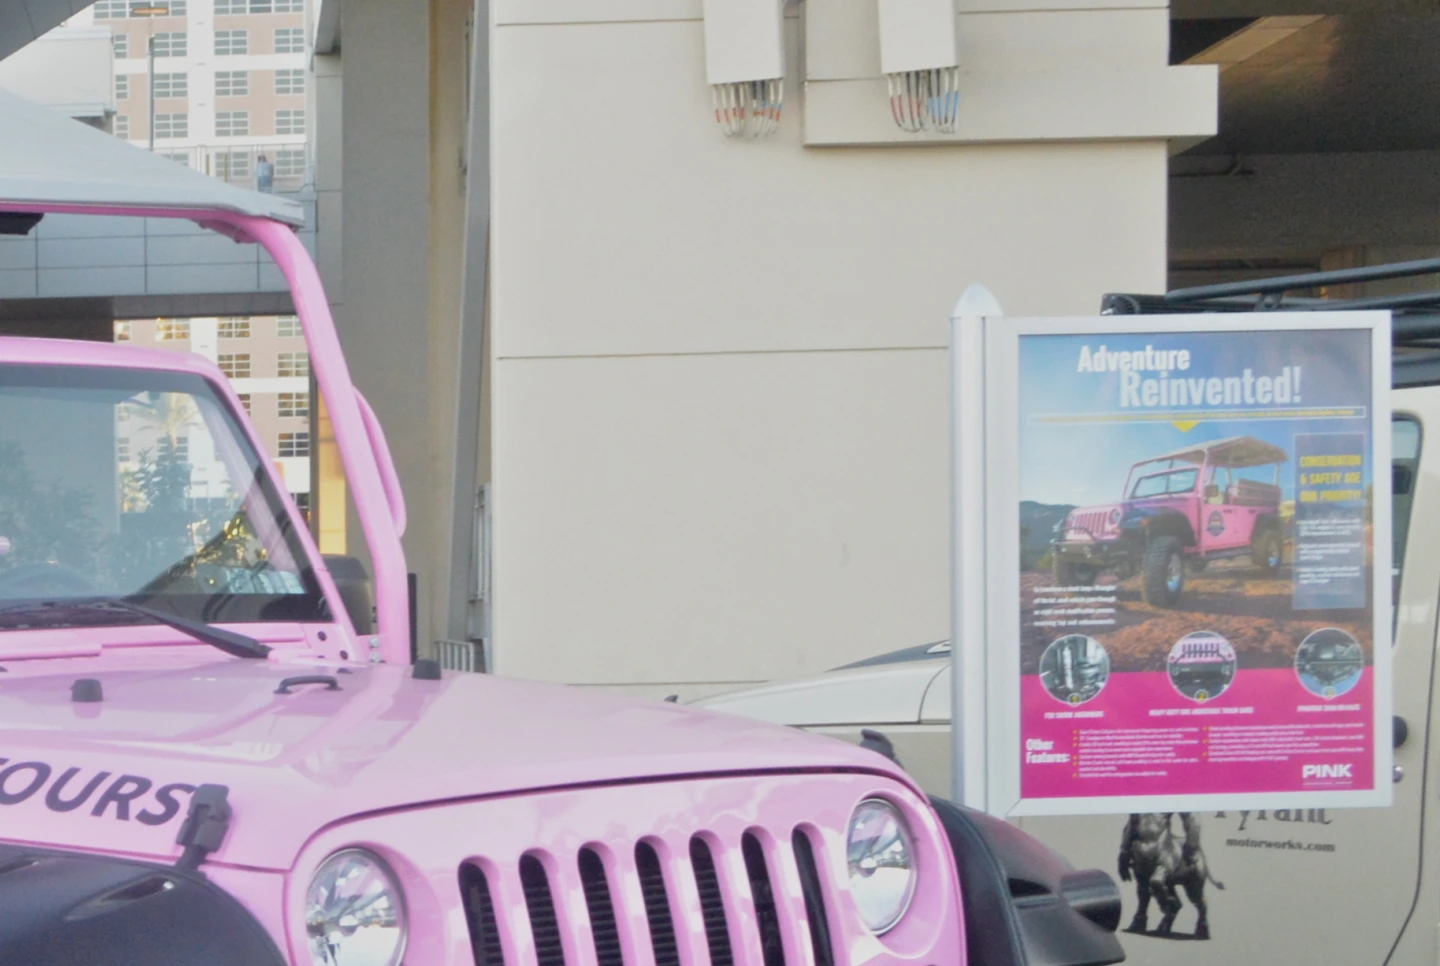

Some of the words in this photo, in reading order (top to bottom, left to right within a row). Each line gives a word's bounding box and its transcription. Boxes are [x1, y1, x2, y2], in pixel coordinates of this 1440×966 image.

[1077, 345, 1190, 372] Adventure
[1120, 366, 1301, 407] Reinvented!
[1302, 764, 1353, 778] PINK
[1226, 838, 1336, 852] motorworks.com
